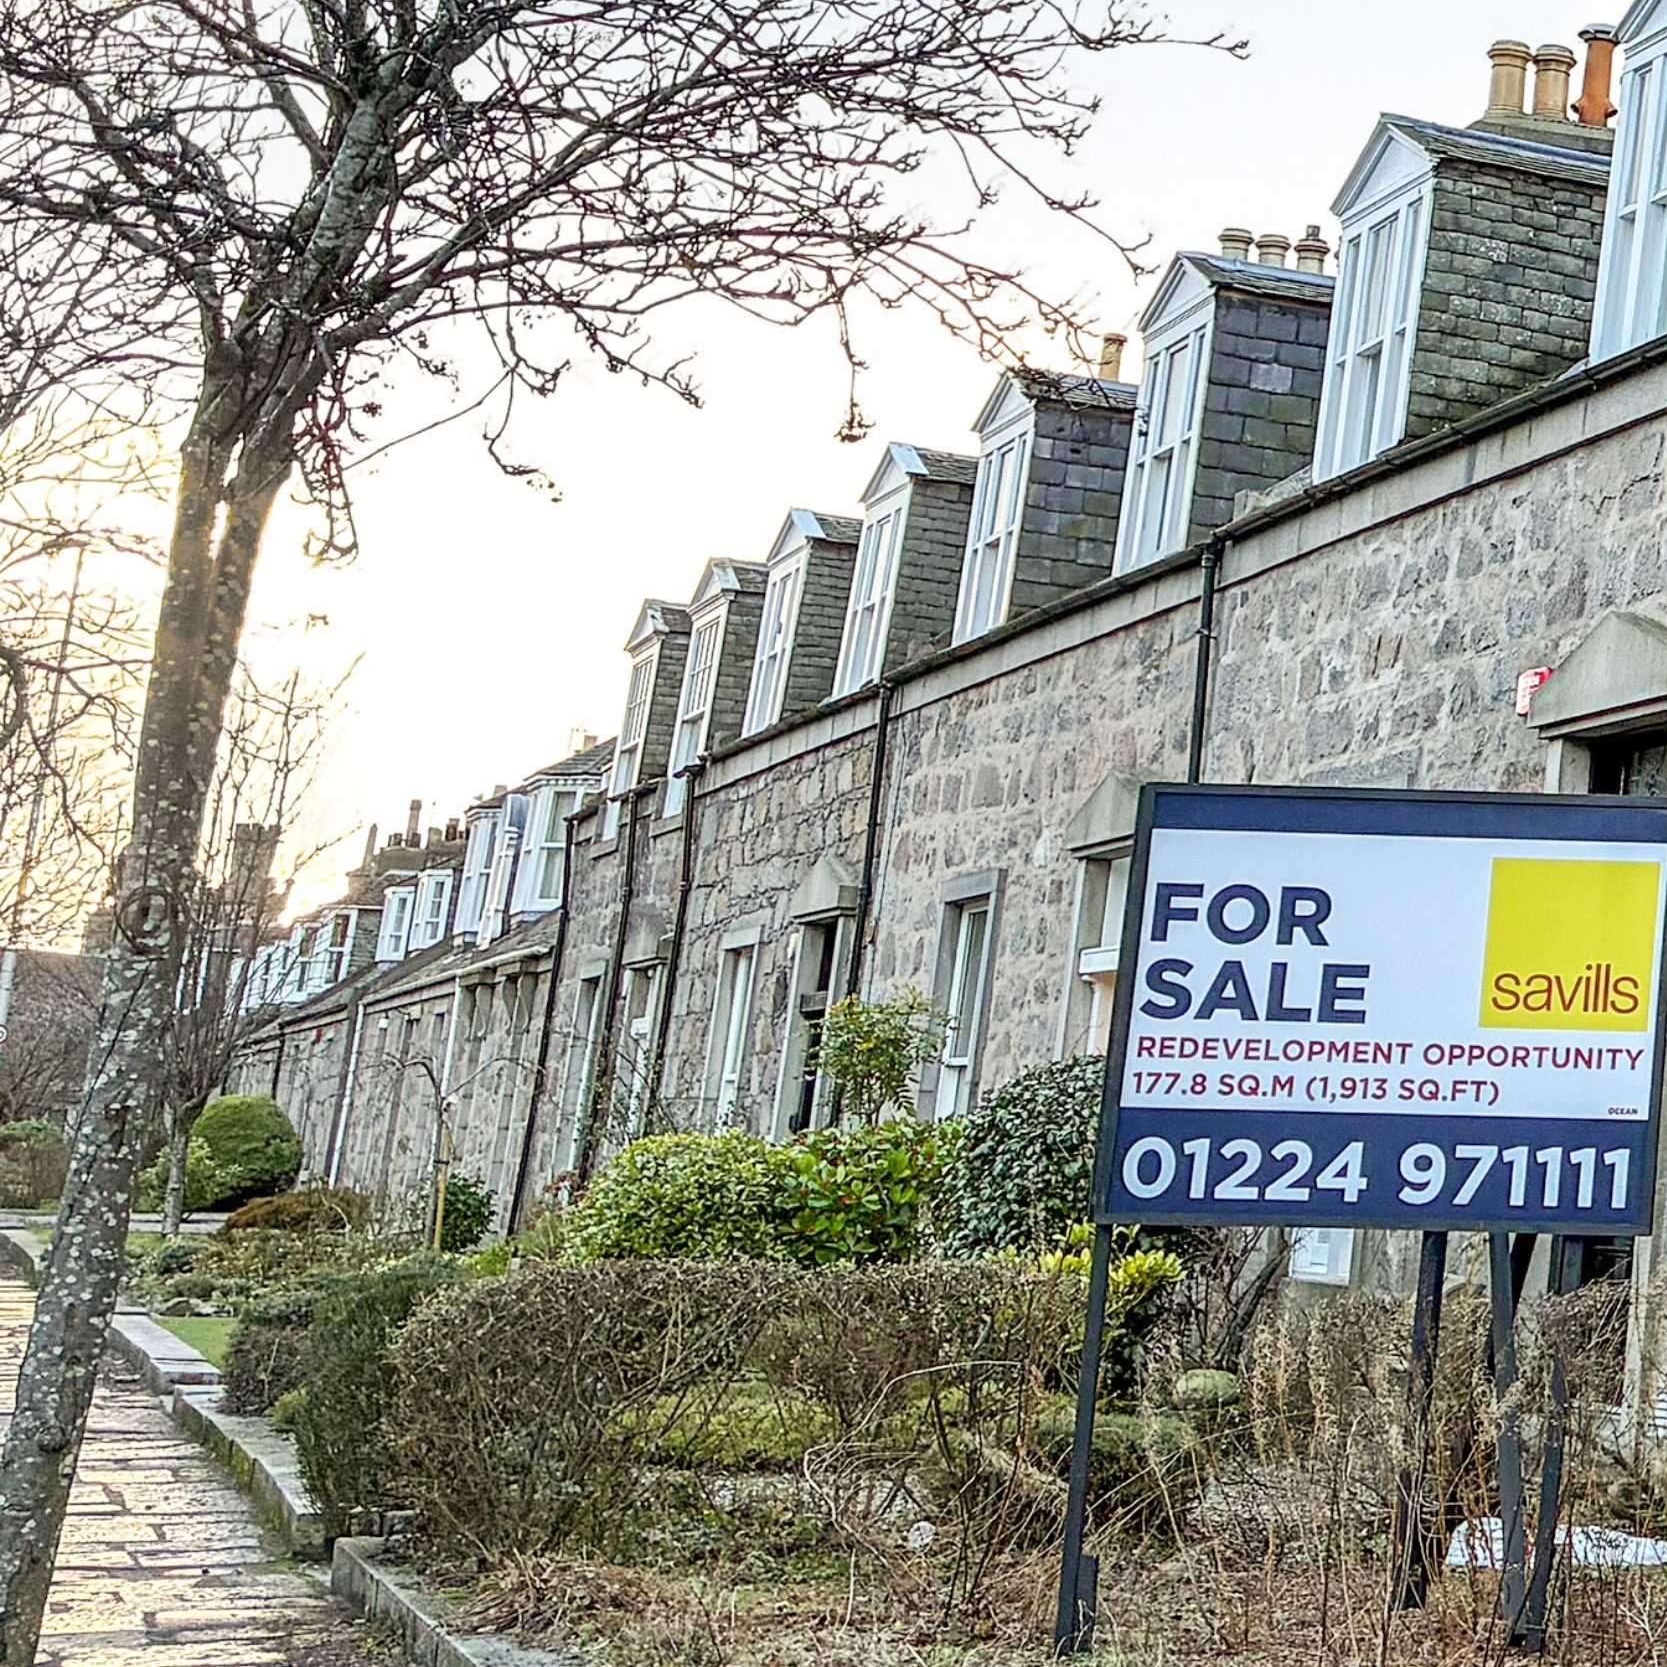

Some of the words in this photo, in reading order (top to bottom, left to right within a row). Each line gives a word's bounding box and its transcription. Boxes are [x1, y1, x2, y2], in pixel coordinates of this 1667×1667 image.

[1149, 882, 1332, 946] FOR
[1139, 957, 1371, 1024] SALE
[1491, 963, 1639, 1015] savills
[1136, 1035, 1414, 1065] REDEVELOPMENT
[1422, 1042, 1645, 1071] OPPORTUNITY
[1132, 1071, 1207, 1096] 177.8
[1217, 1073, 1295, 1100] SQ.M
[1305, 1076, 1388, 1104] (1,913
[1397, 1077, 1500, 1107] SQ.FT)
[1122, 1136, 1368, 1203] 01224
[1398, 1142, 1631, 1209] 971111
